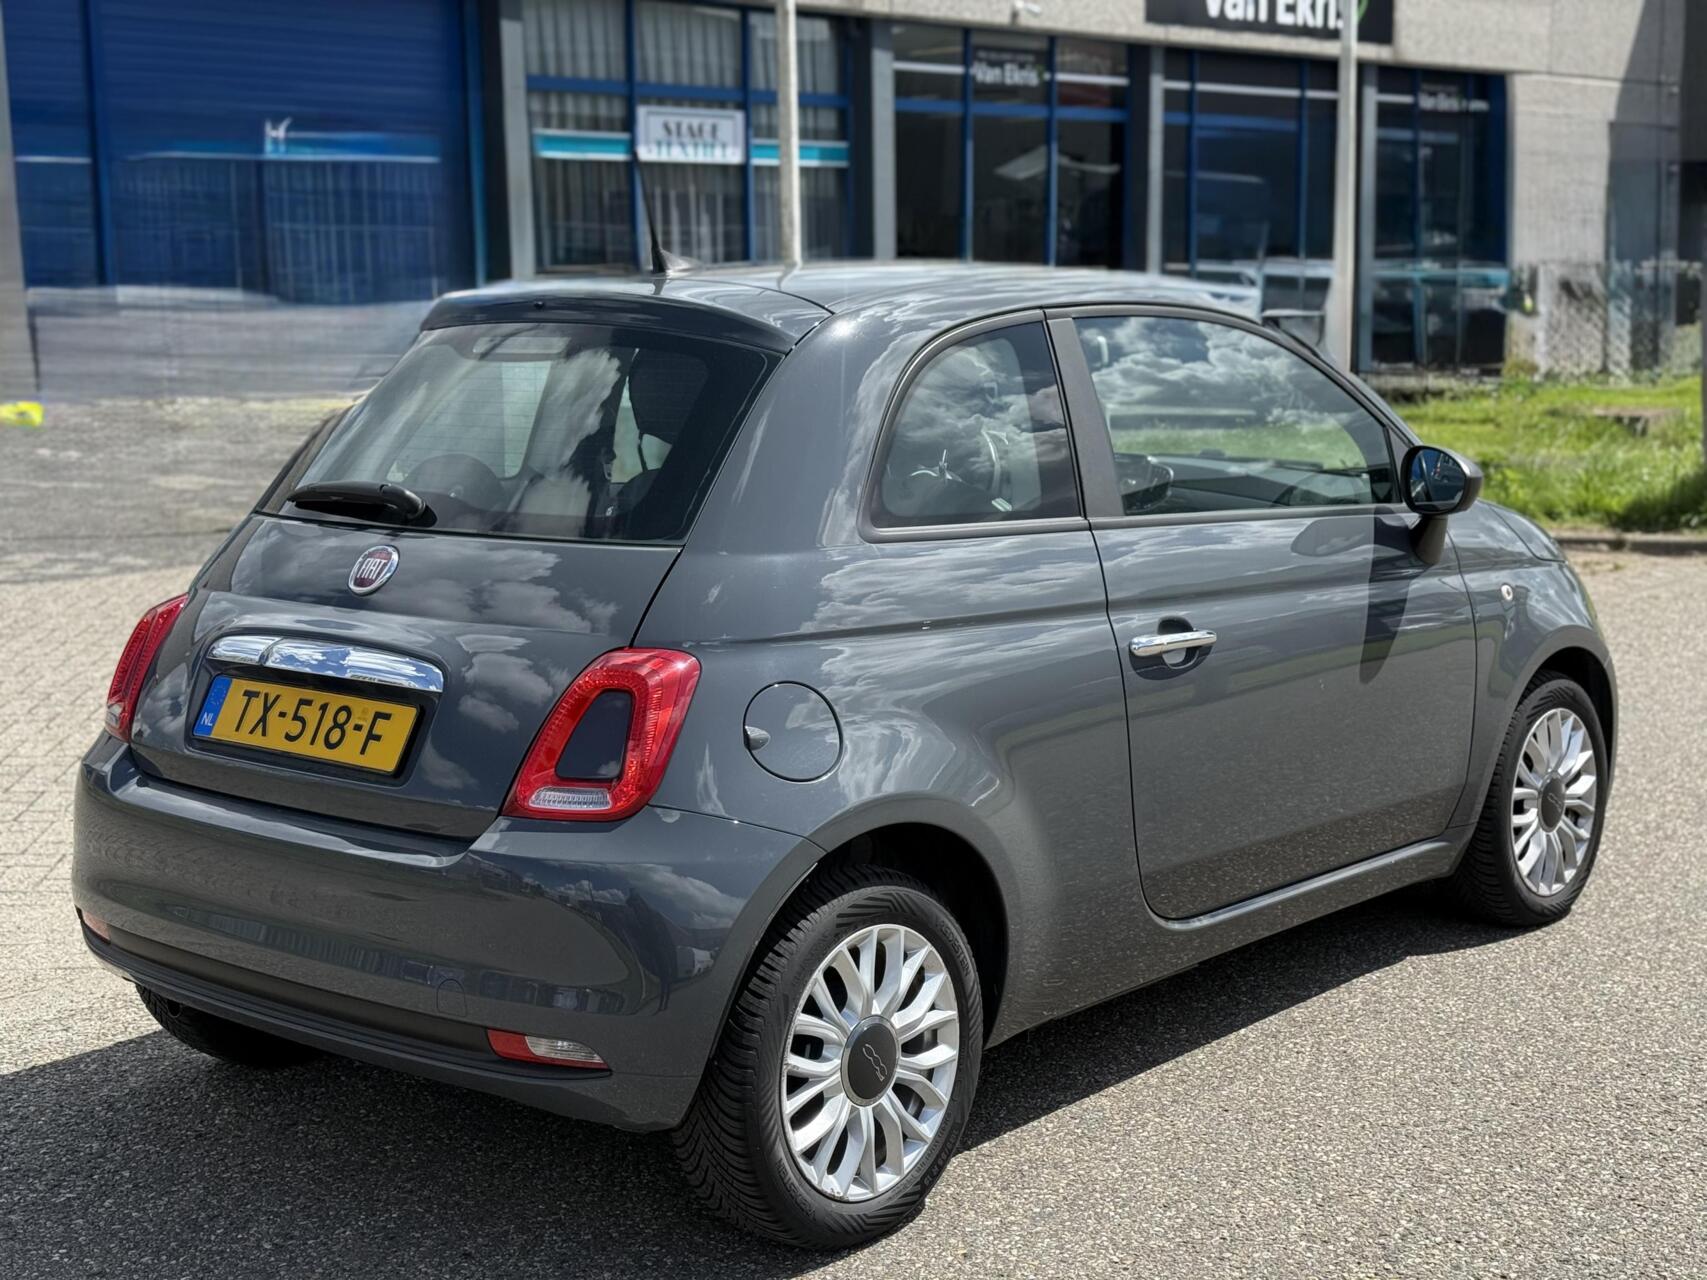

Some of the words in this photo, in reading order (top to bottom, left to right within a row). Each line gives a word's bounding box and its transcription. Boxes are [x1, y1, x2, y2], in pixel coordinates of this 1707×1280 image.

[1275, 0, 1344, 30] Ekri
[357, 557, 388, 580] FIAT
[201, 712, 213, 727] NL
[235, 690, 392, 755] TX-518-F
